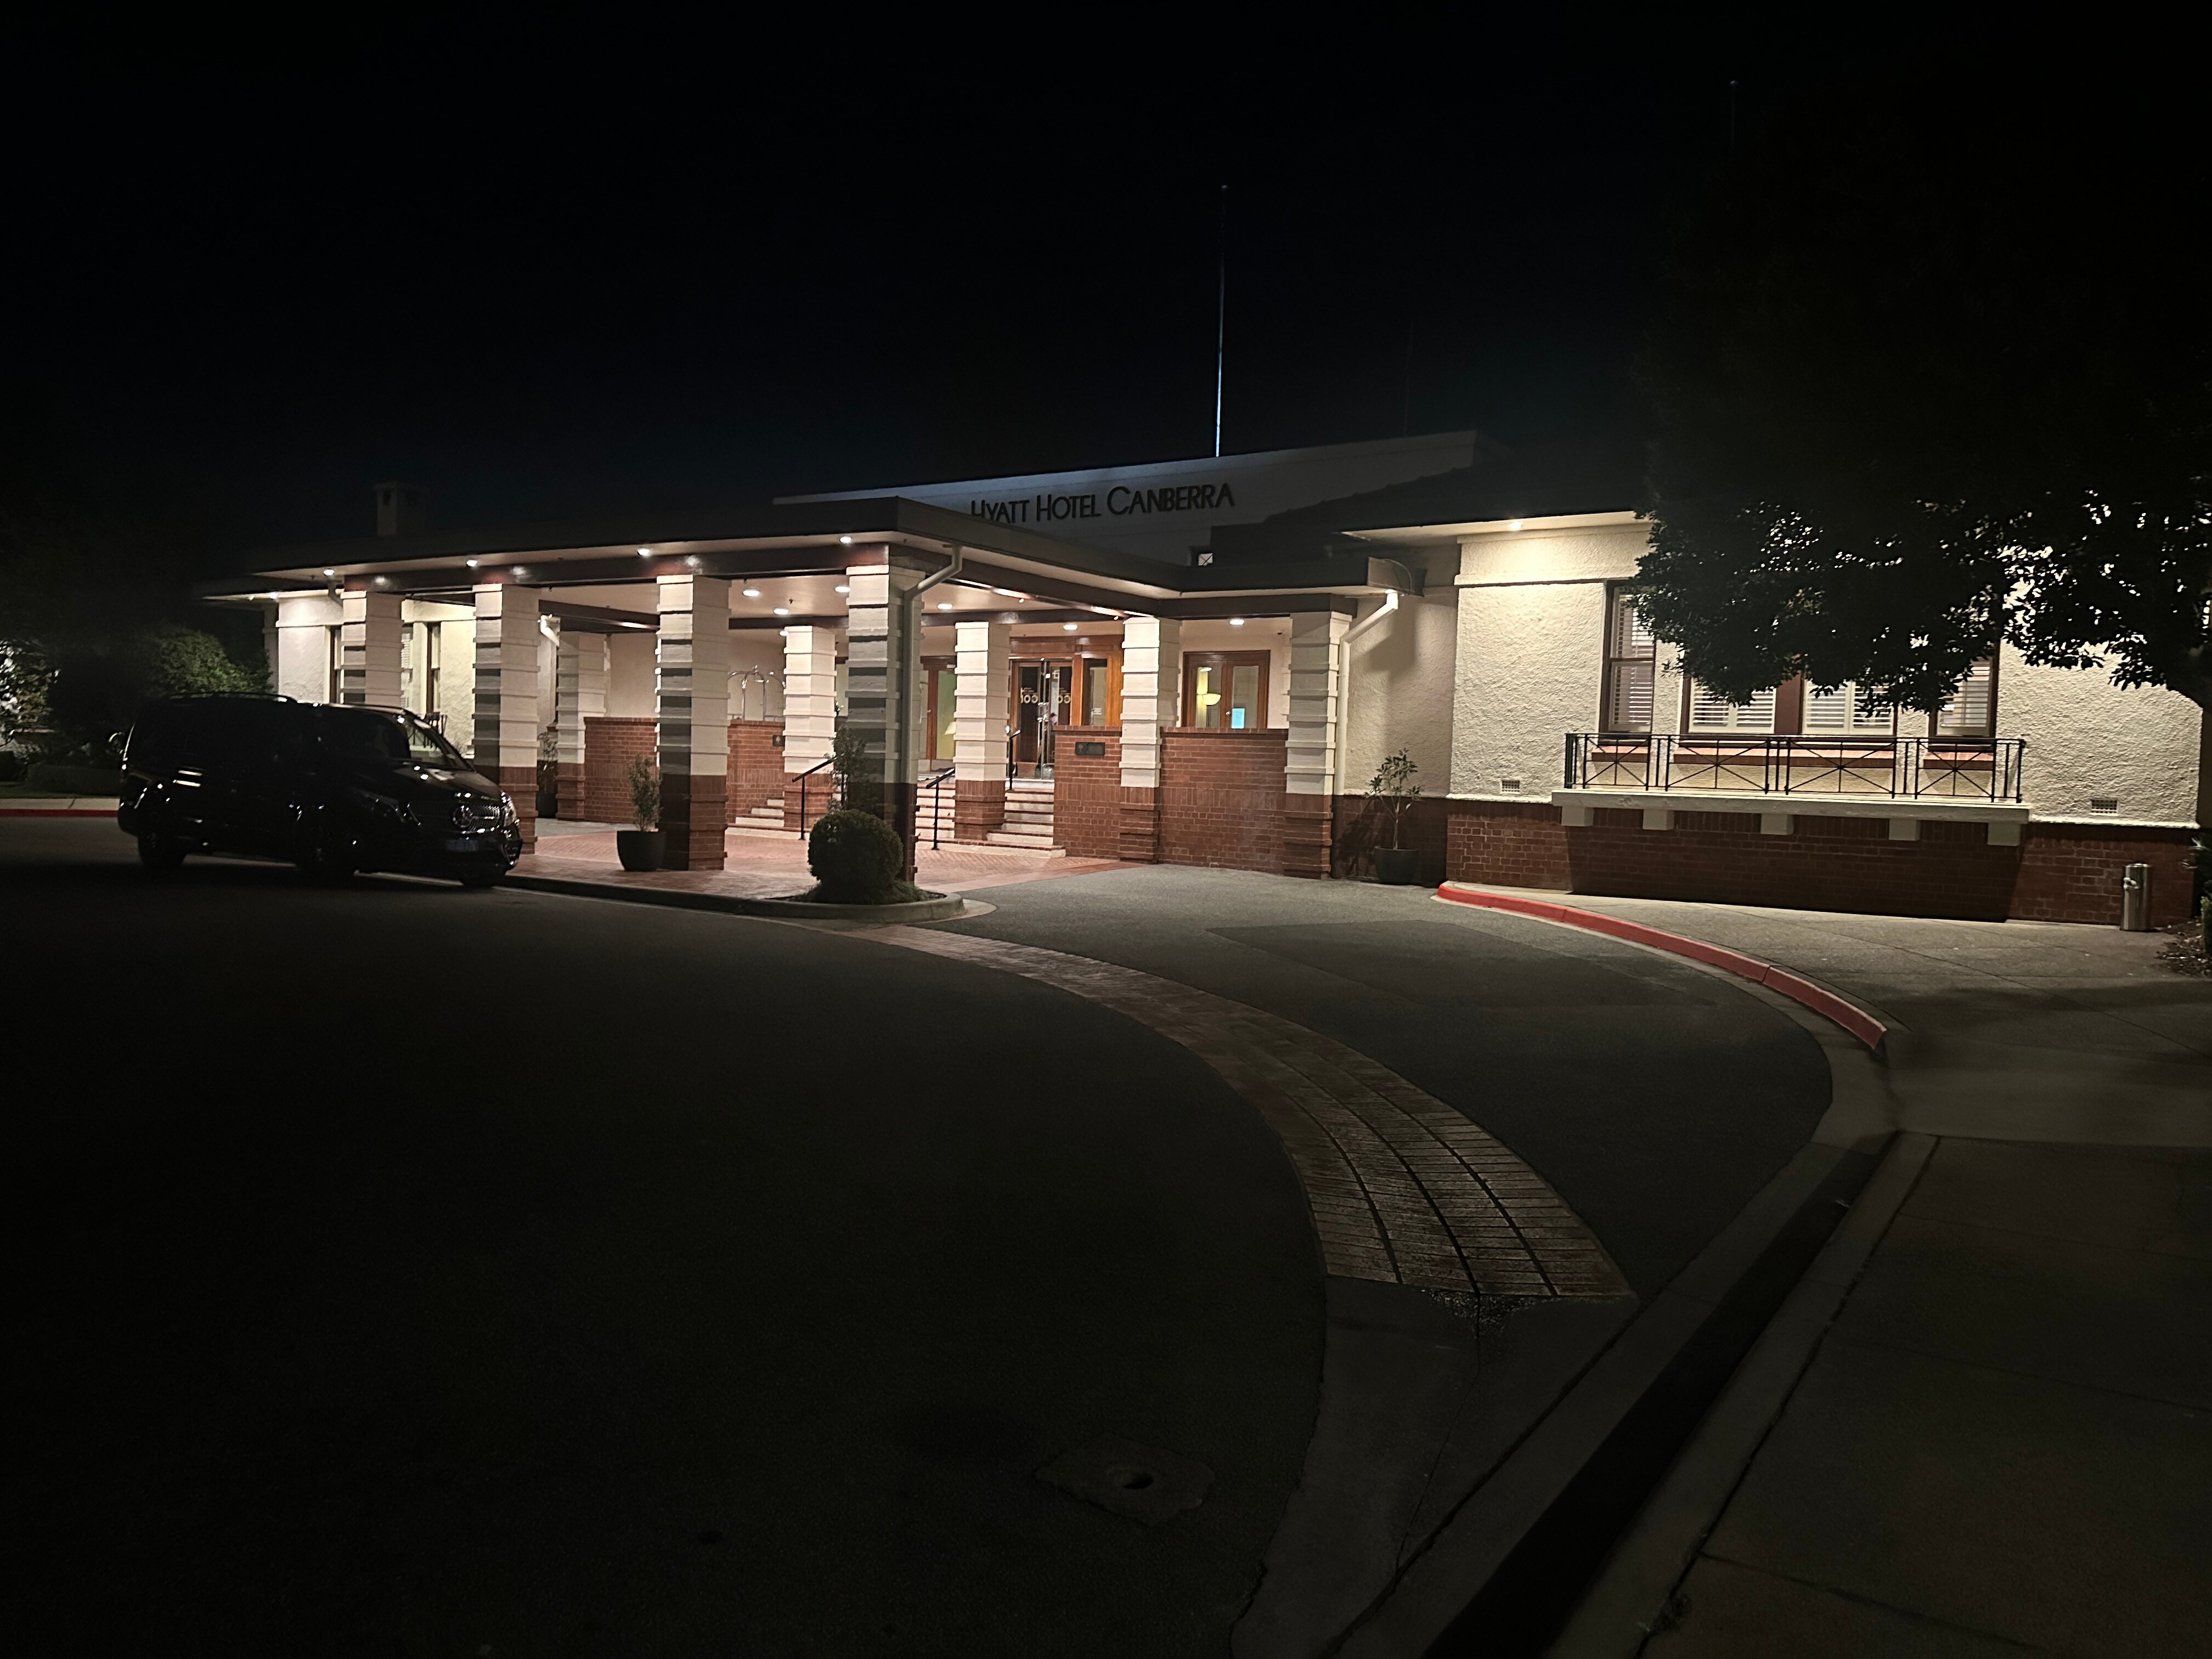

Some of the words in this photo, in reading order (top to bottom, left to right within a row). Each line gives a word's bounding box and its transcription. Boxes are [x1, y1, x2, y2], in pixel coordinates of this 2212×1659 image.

[972, 500, 1030, 523] HYATT
[1036, 494, 1102, 521] HOTEL
[1107, 482, 1235, 515] CANBERRA
